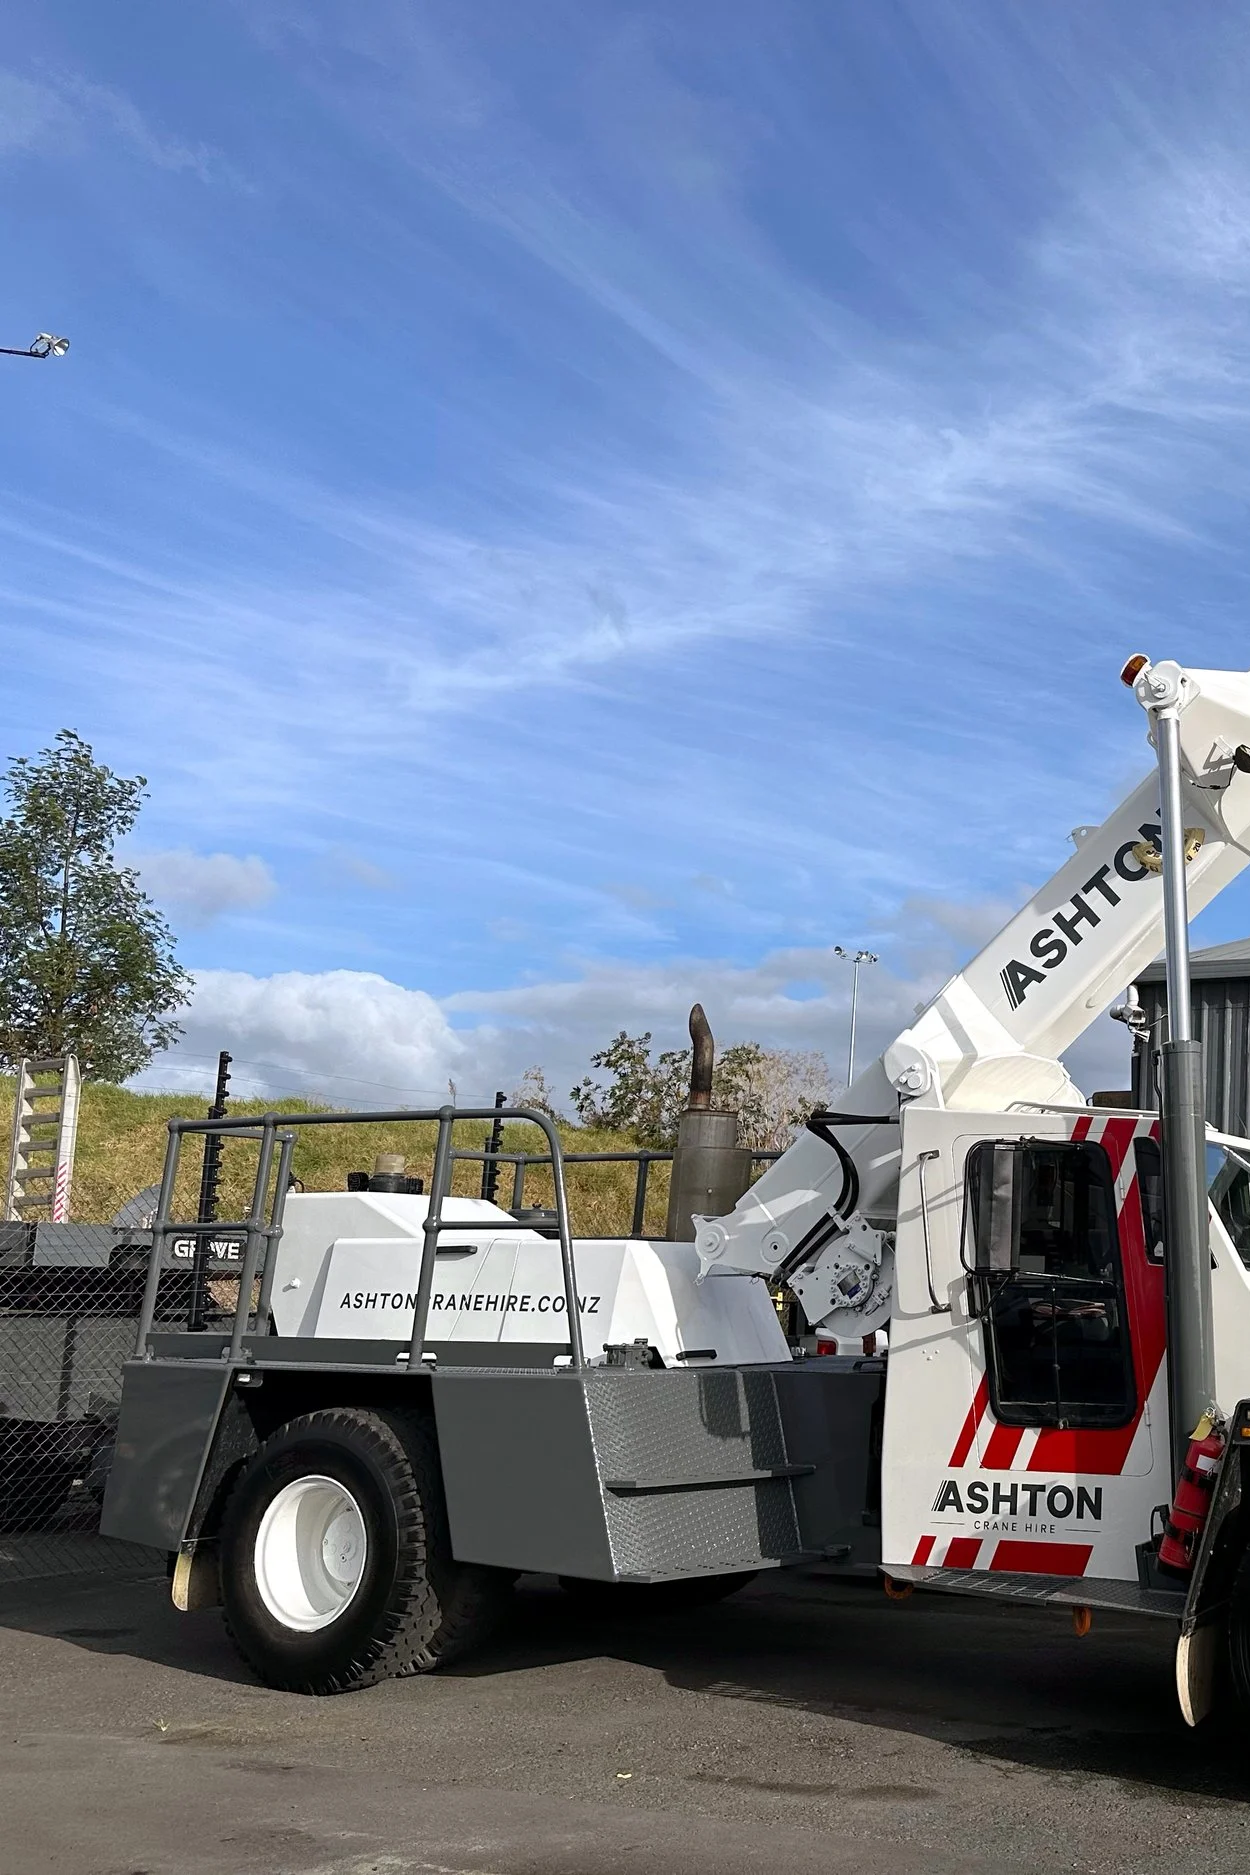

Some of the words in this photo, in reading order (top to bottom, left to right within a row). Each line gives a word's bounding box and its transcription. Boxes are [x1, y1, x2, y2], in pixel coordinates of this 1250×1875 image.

[340, 1292, 601, 1314] ASHTONRANEHIRE.CO.NZ
[931, 1480, 1103, 1521] ASHTON
[974, 1520, 1018, 1532] CRANE
[1025, 1522, 1057, 1534] HIRE
